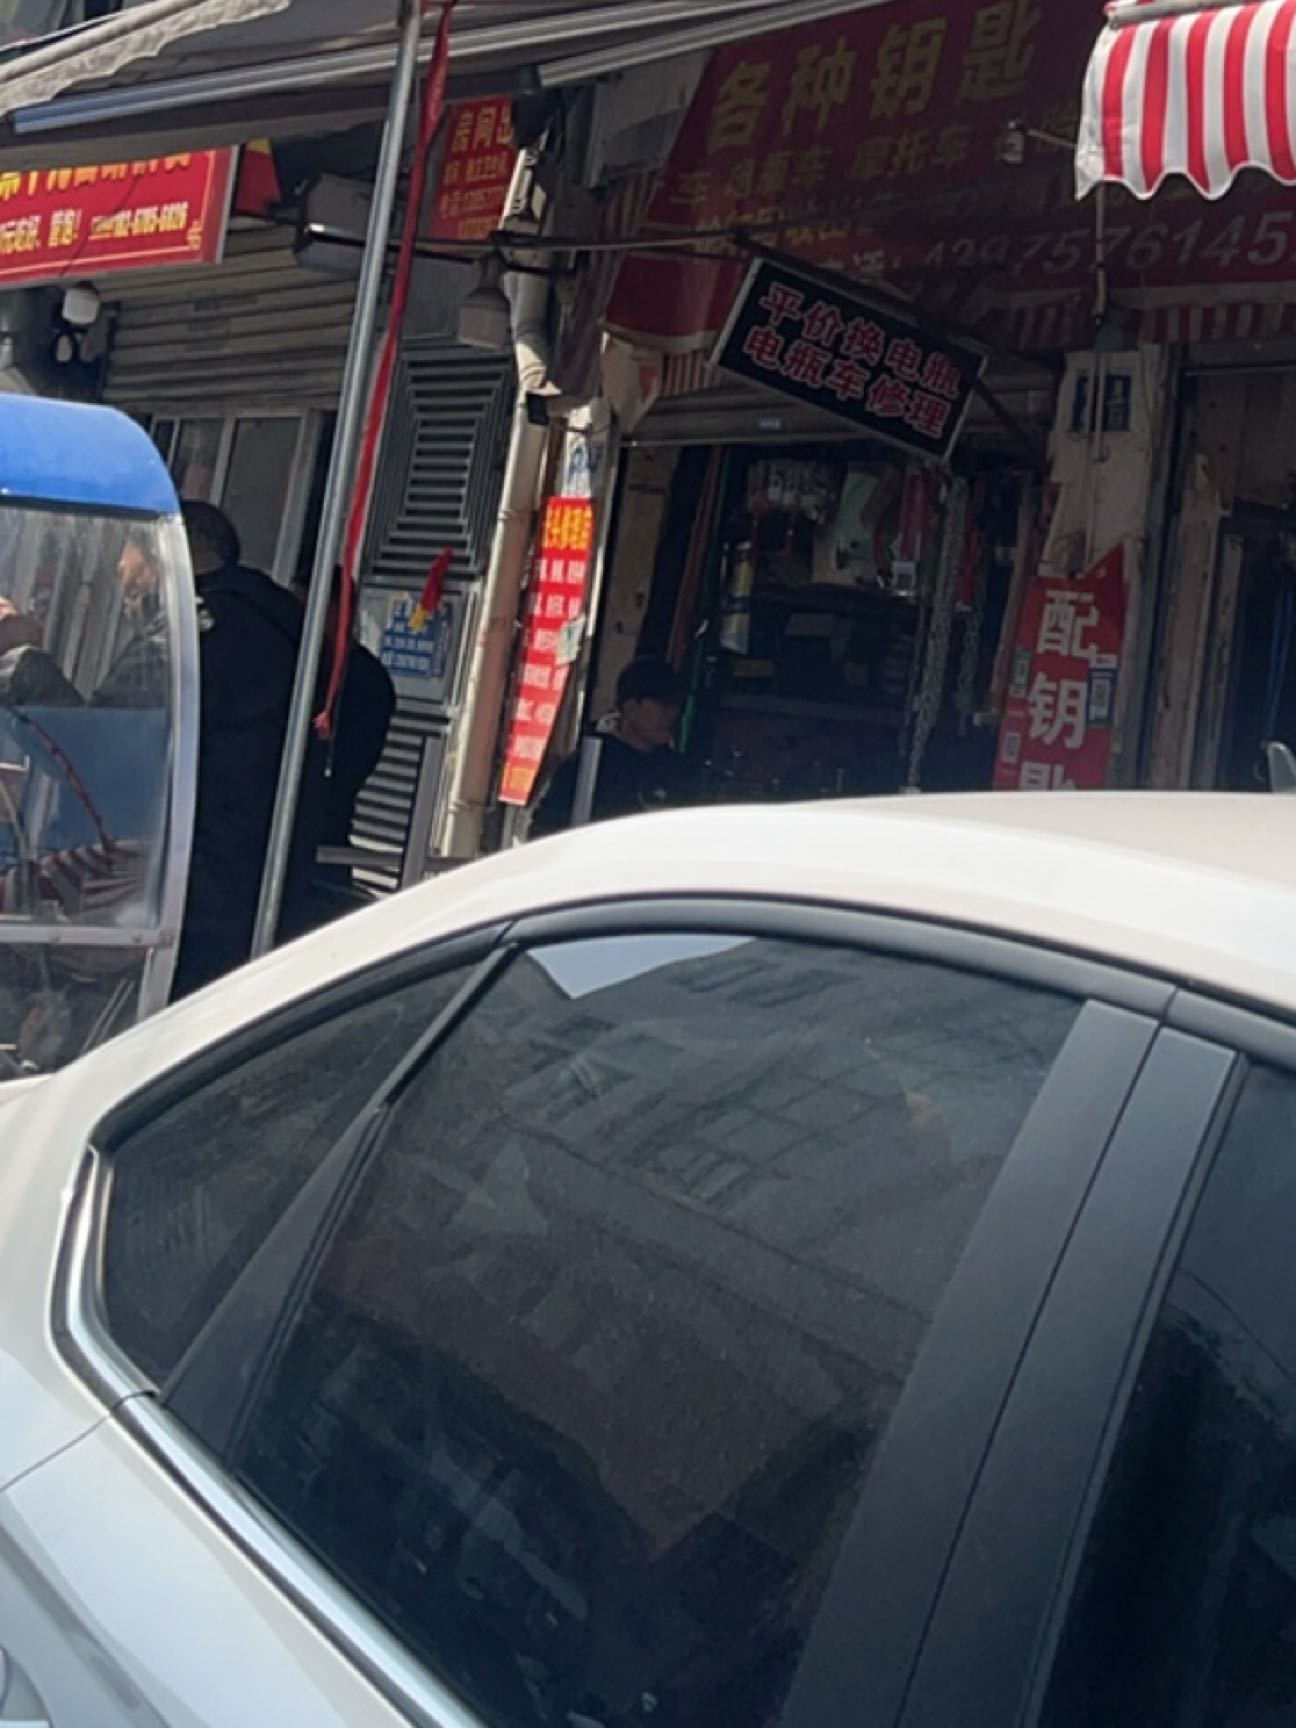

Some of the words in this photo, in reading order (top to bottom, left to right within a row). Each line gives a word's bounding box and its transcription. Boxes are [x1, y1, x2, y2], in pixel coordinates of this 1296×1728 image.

[744, 325, 953, 439] 电瓶车修理
[758, 280, 962, 399] 平价换电瓶
